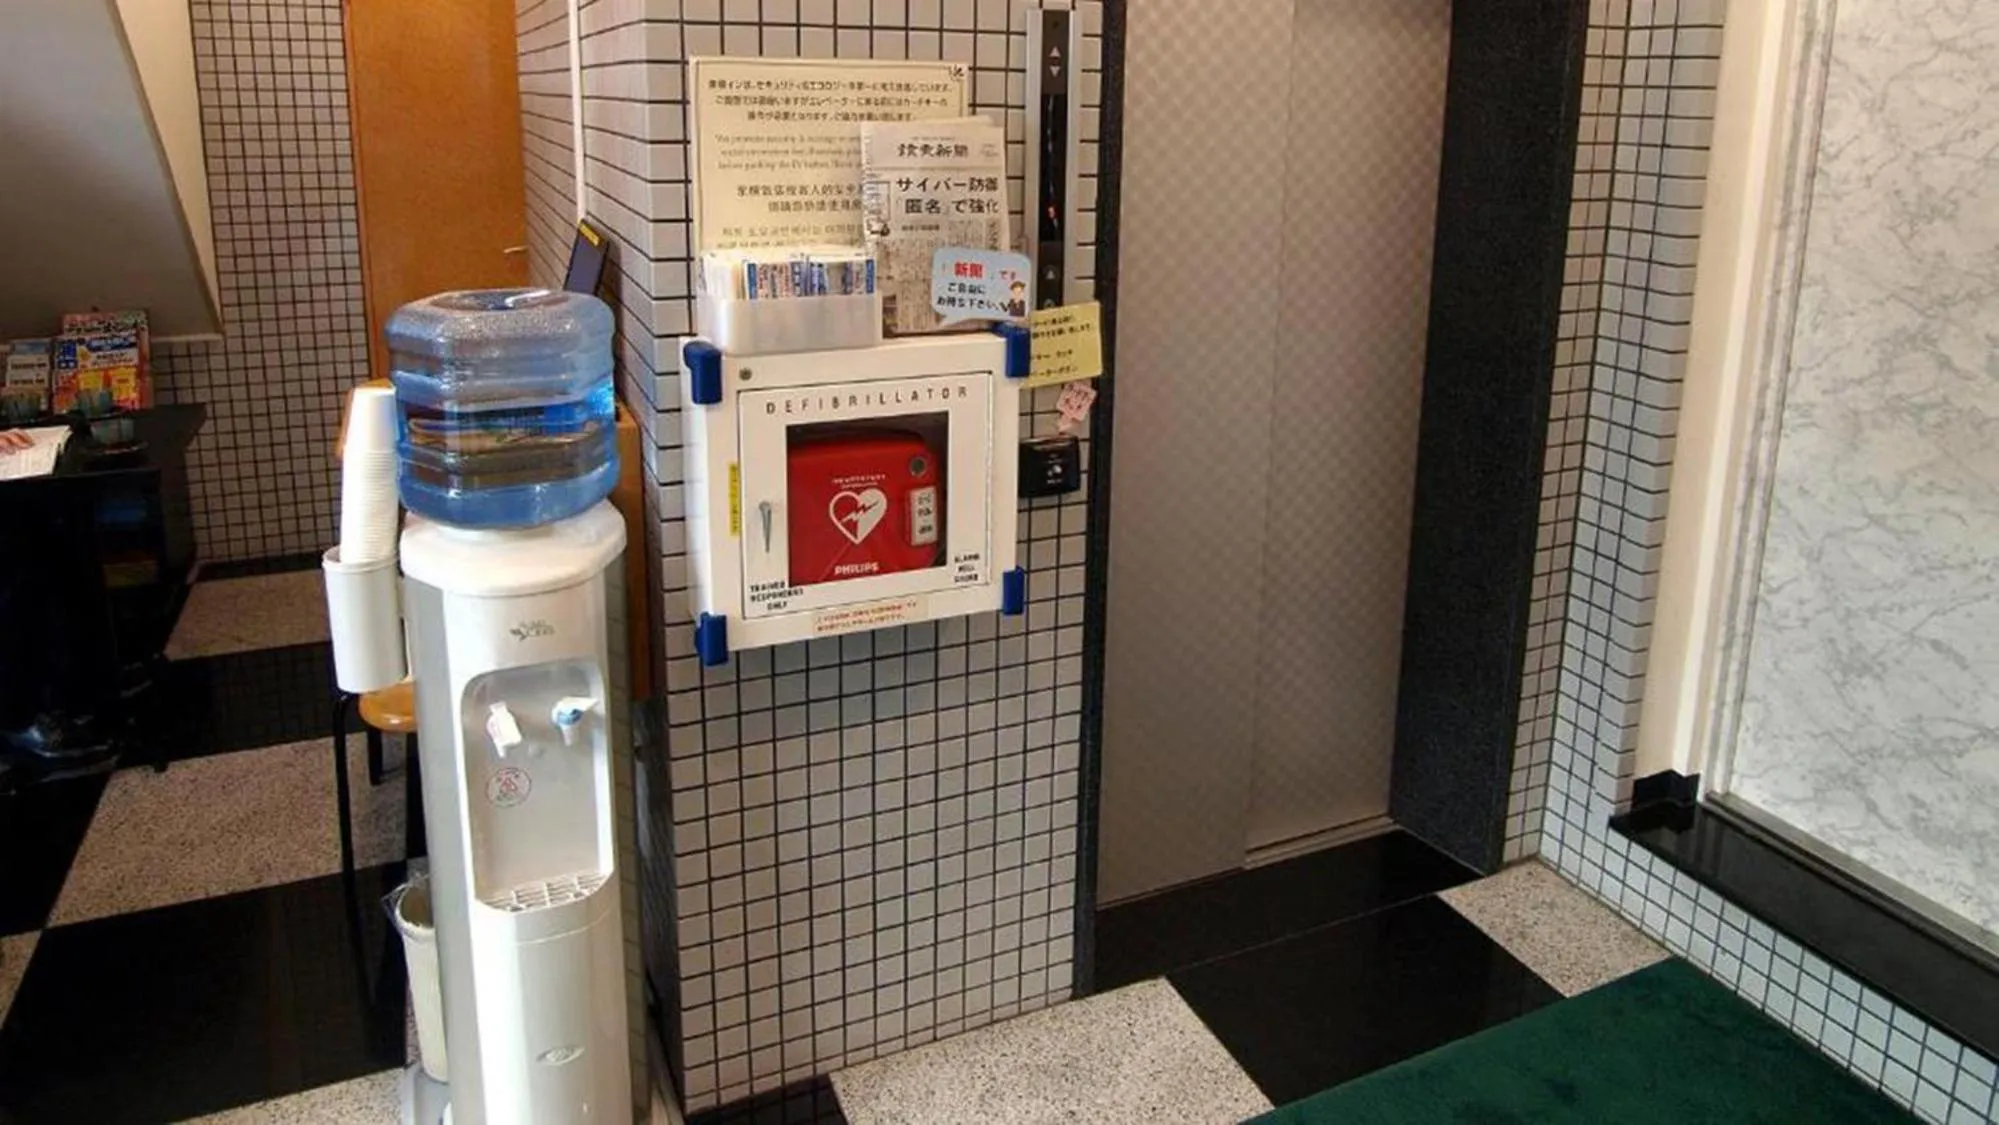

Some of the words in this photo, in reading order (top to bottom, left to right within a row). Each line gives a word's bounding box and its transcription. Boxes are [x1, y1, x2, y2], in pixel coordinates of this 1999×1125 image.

[897, 177, 998, 192] サイバー防御
[766, 386, 968, 415] DEFIBRILLATOR
[835, 561, 880, 577] PHILIPS
